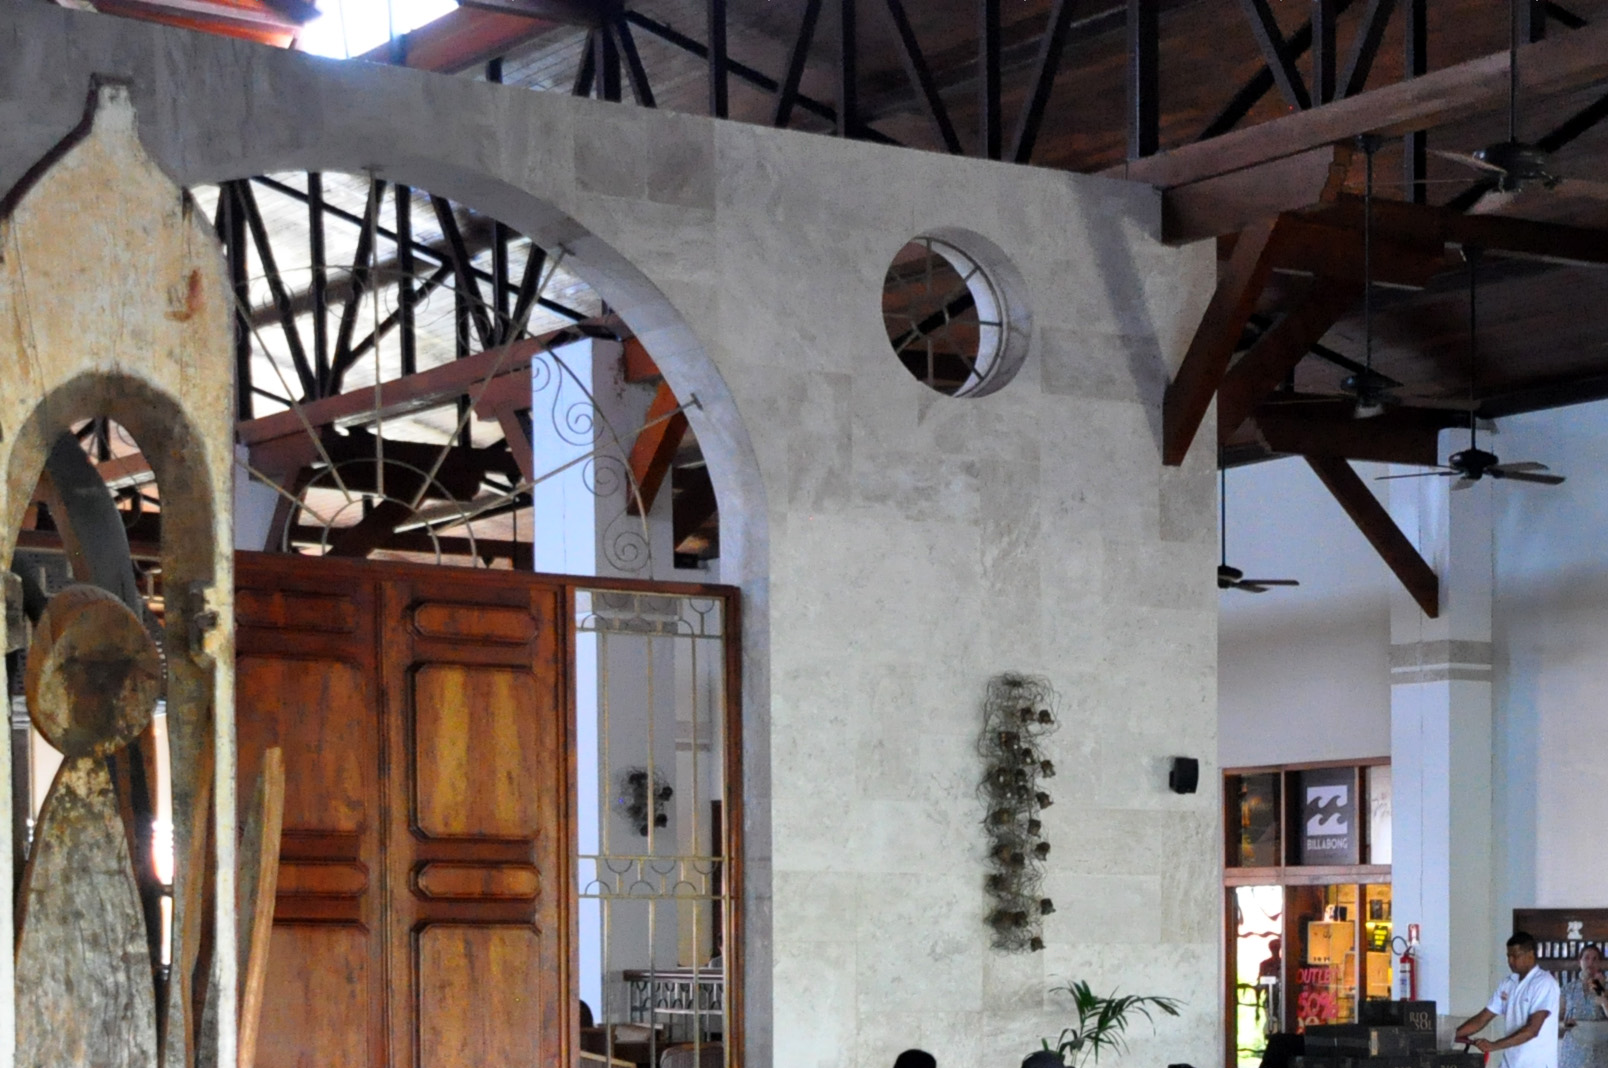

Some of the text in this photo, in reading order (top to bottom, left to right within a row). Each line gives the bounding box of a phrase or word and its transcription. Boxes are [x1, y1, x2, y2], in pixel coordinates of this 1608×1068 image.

[1306, 838, 1348, 850] BILLABONG
[1296, 991, 1338, 1019] 50%
[1409, 1011, 1428, 1024] RIO
[1415, 1019, 1432, 1030] SOL
